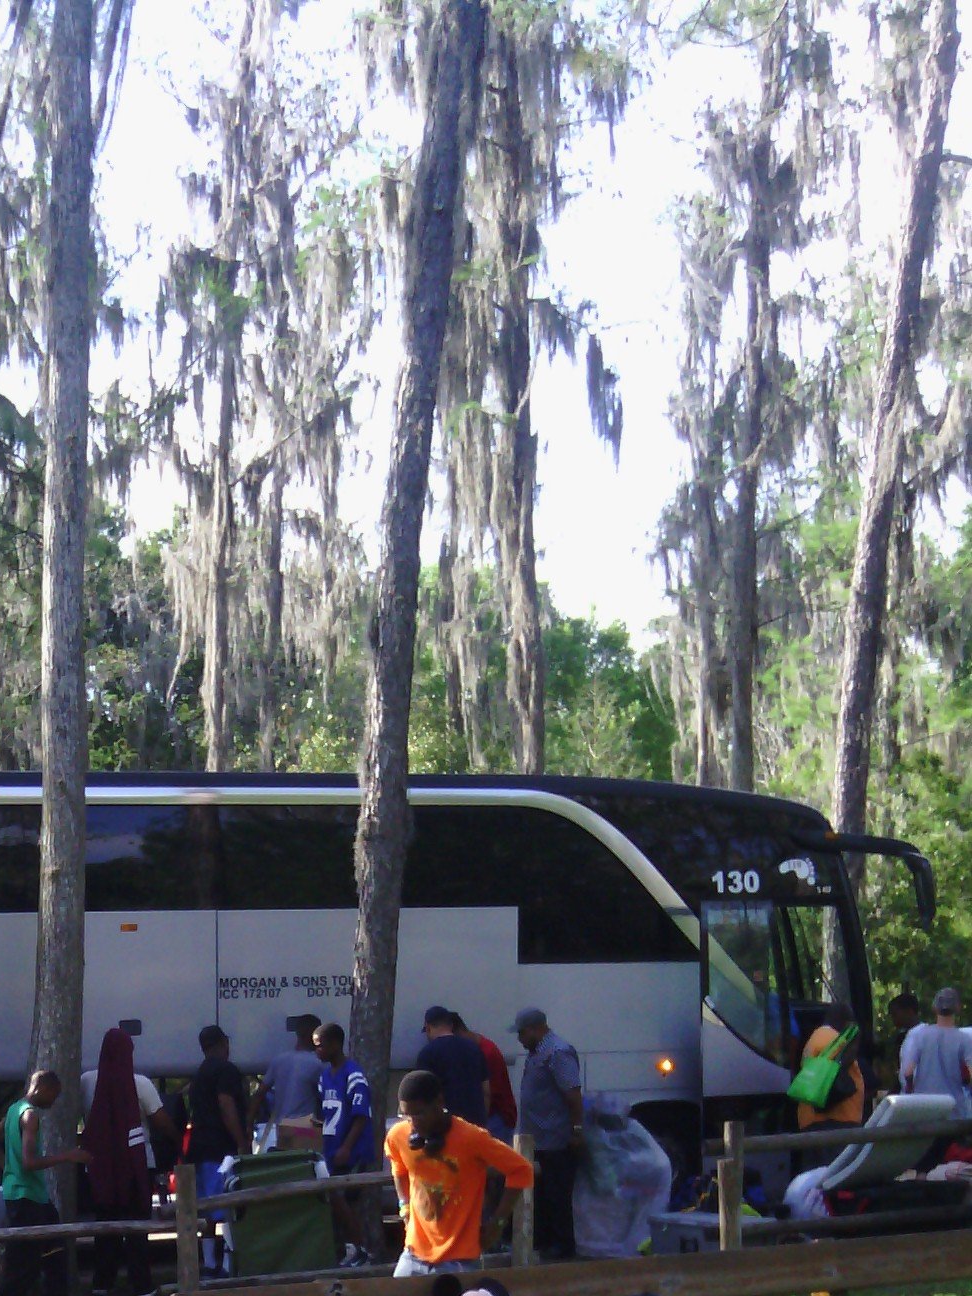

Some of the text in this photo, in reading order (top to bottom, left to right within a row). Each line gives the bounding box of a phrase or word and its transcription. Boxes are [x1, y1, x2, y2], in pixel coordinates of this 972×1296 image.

[711, 870, 760, 894] 130
[219, 977, 276, 988] MORGAN
[280, 976, 288, 988] &
[292, 975, 327, 987] SONS
[219, 988, 239, 999] ICC
[243, 987, 281, 999] 172107
[307, 986, 330, 998] DOT
